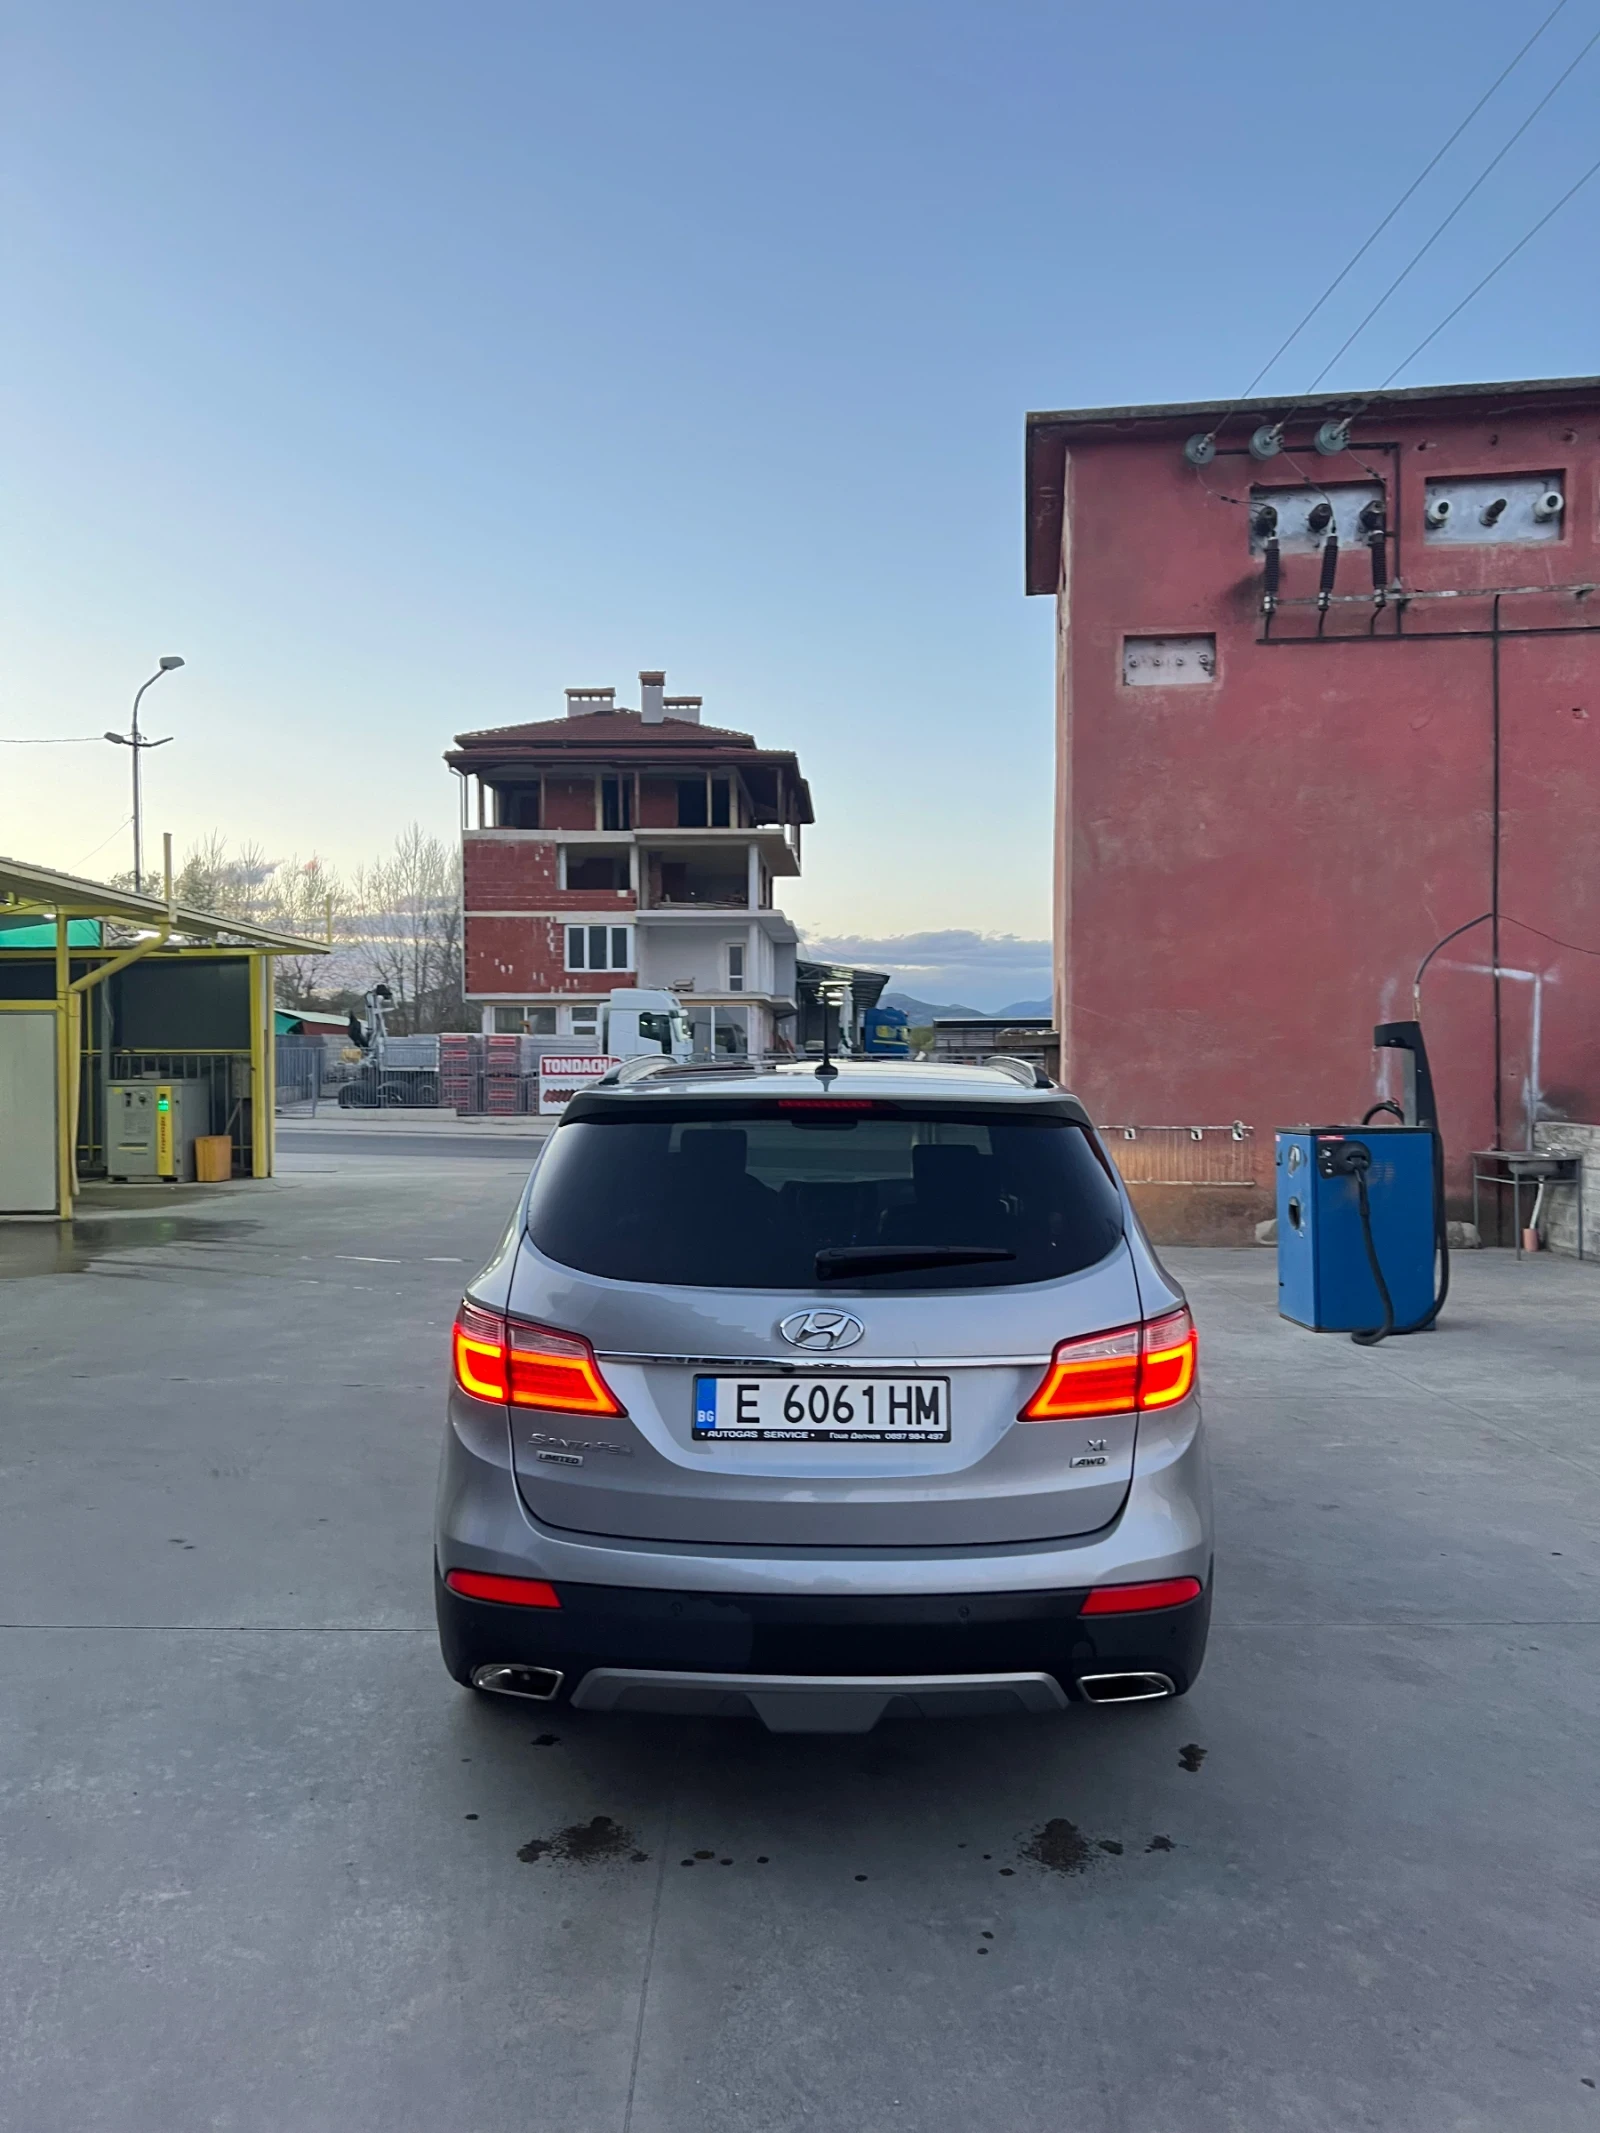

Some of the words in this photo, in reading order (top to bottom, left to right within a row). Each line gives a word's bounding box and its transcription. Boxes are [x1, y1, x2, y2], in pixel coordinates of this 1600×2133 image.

[543, 1058, 607, 1073] TONDACH
[736, 1384, 760, 1424] E
[783, 1384, 875, 1424] 6061
[888, 1386, 940, 1426] HM
[697, 1410, 715, 1423] BG
[707, 1430, 759, 1438] AUTOGAS
[763, 1431, 809, 1439] SERVICE
[1084, 1439, 1112, 1453] XL
[538, 1453, 580, 1465] LIMITED
[1075, 1457, 1106, 1466] AWD
